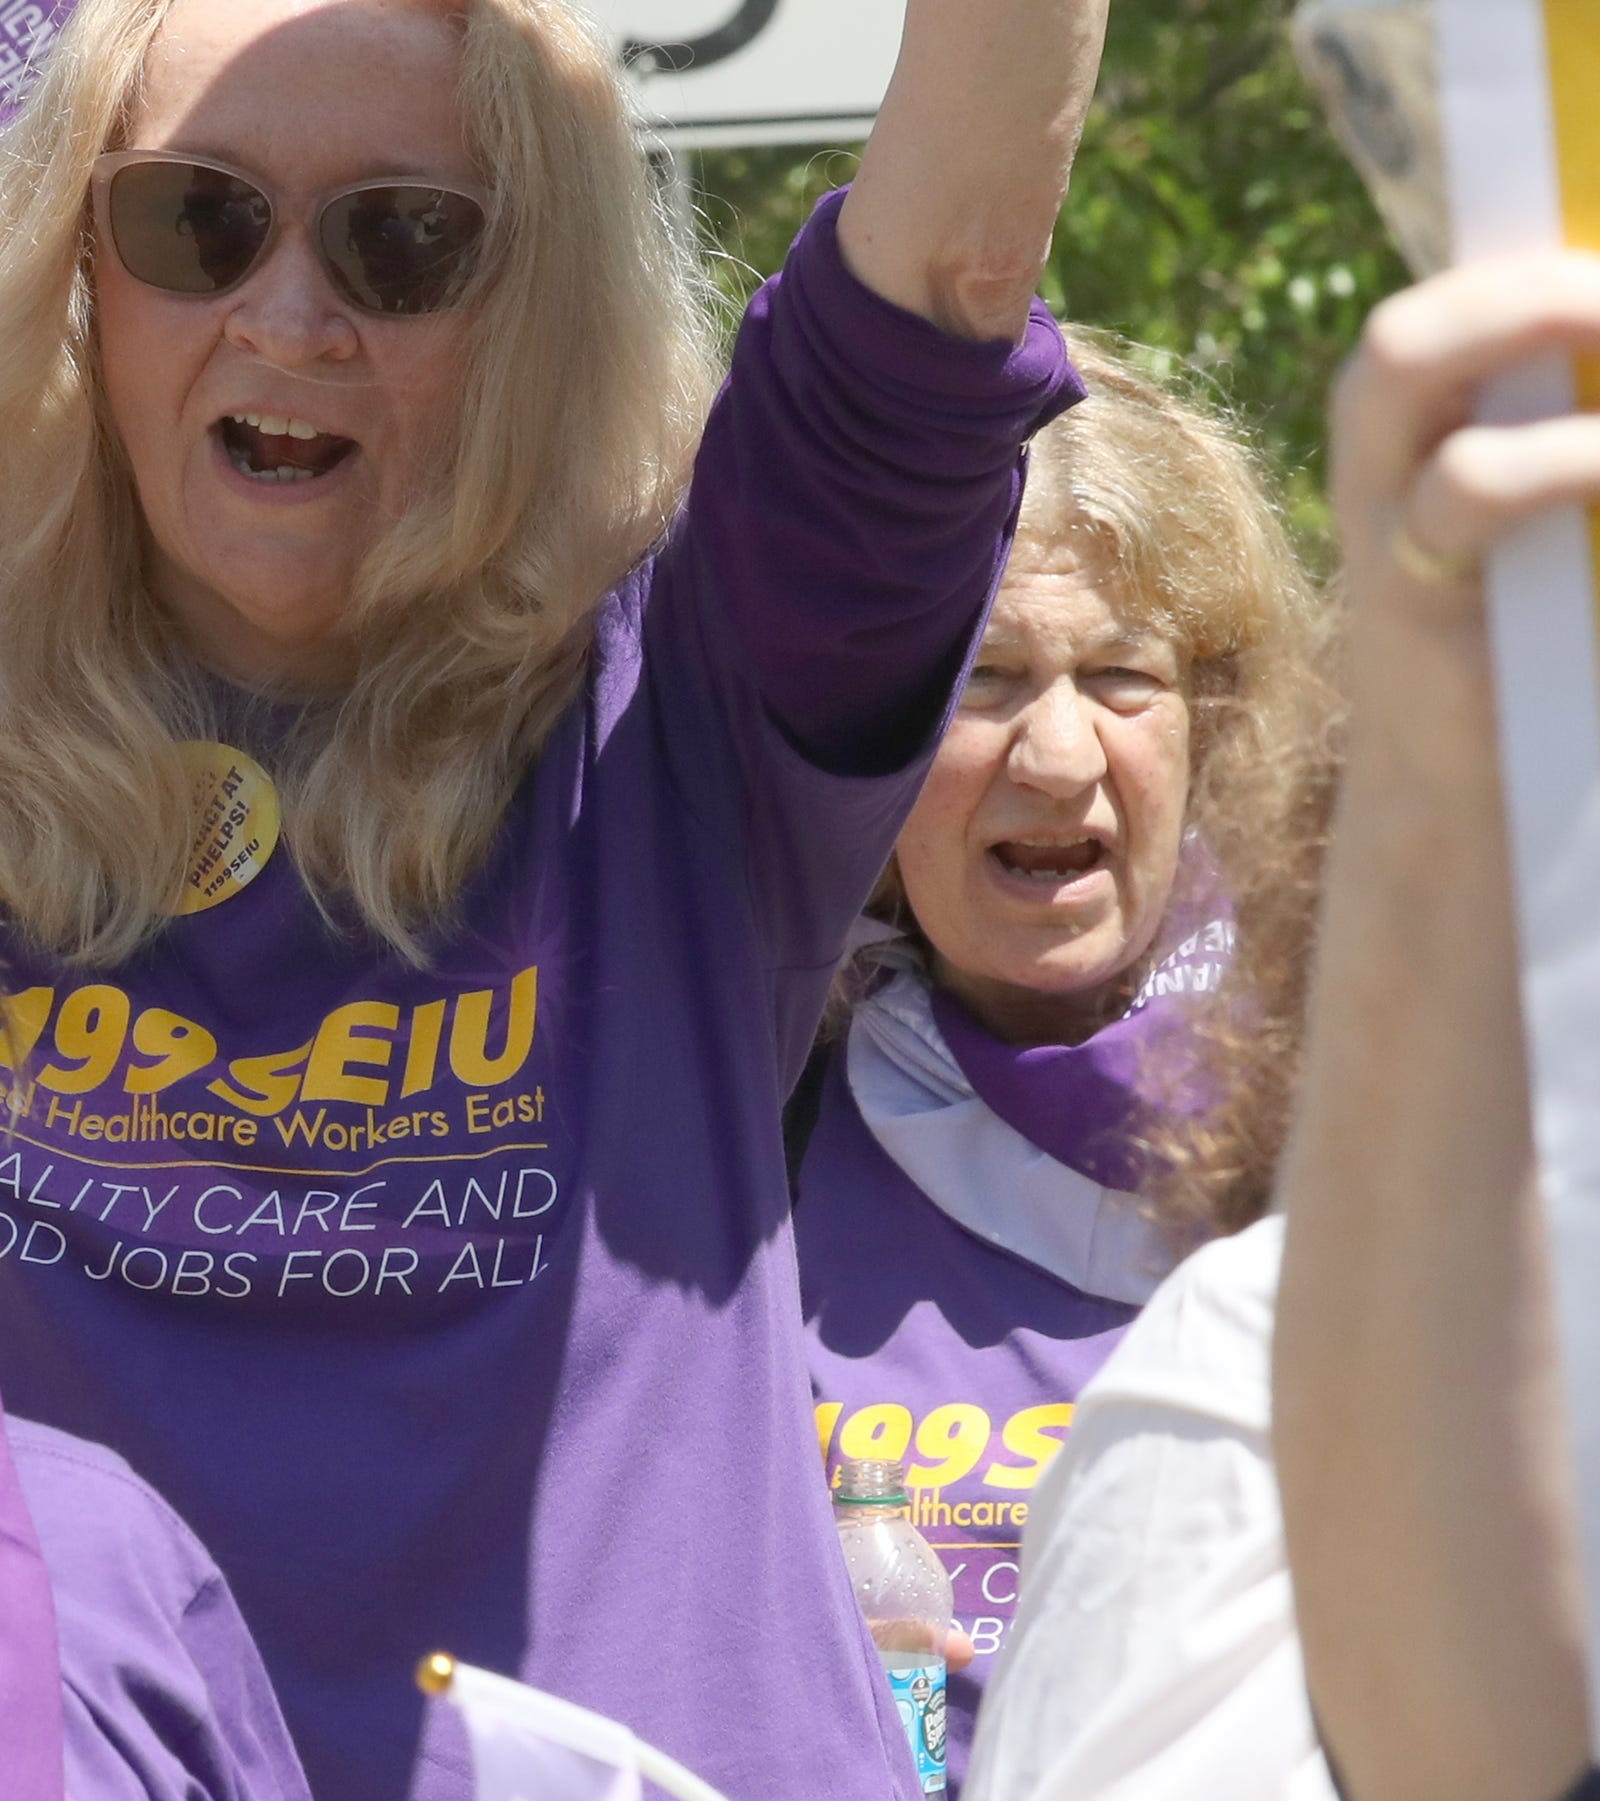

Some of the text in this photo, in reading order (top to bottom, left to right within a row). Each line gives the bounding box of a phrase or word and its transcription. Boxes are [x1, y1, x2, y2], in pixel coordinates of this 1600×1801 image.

[222, 765, 244, 800] AT
[190, 800, 250, 889] PHELPS!
[203, 838, 260, 897] 1199SEIU
[45, 1092, 258, 1147] Healthcare
[273, 1108, 450, 1151] Workers
[465, 1086, 545, 1134] East
[194, 1181, 387, 1235] CARE
[401, 1168, 558, 1229] AND
[84, 1241, 258, 1297] JOBS
[277, 1248, 418, 1297] FOR
